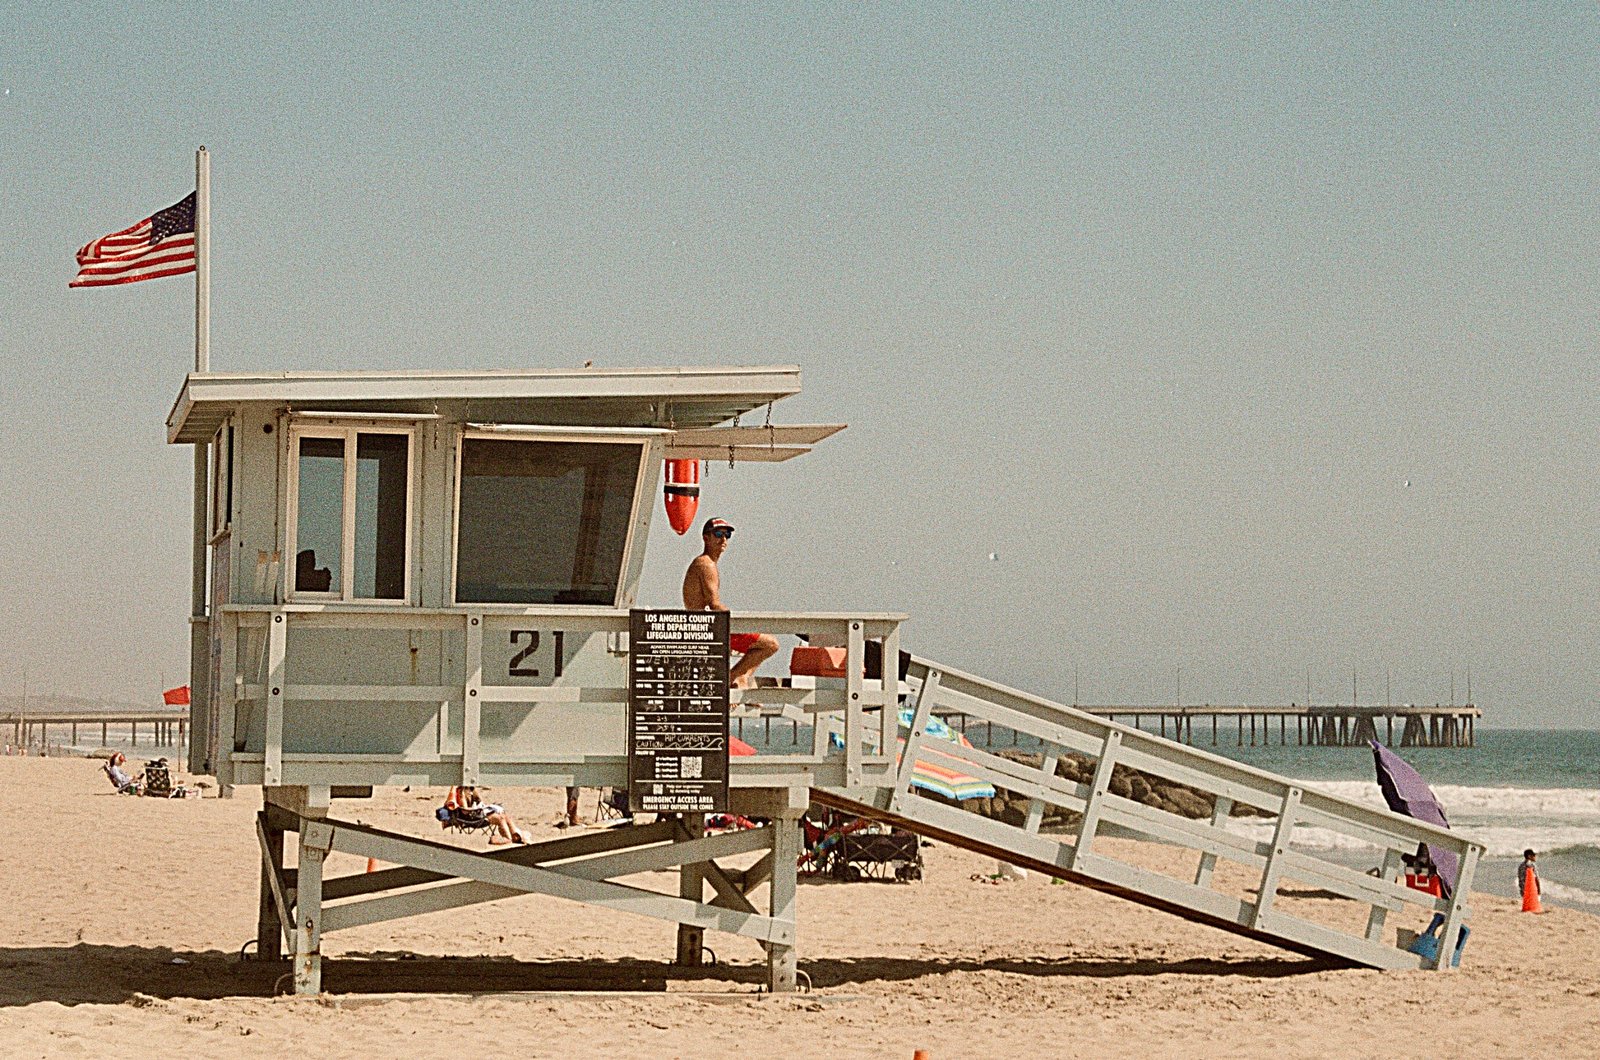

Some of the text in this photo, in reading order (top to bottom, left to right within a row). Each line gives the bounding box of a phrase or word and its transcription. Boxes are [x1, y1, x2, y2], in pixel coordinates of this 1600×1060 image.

[645, 614, 715, 623] LOS ANGELES COUNTY
[651, 623, 709, 632] FIRE DEPARTMENT
[647, 632, 713, 640] LIFEGUARD DIVISION
[509, 630, 563, 677] 21
